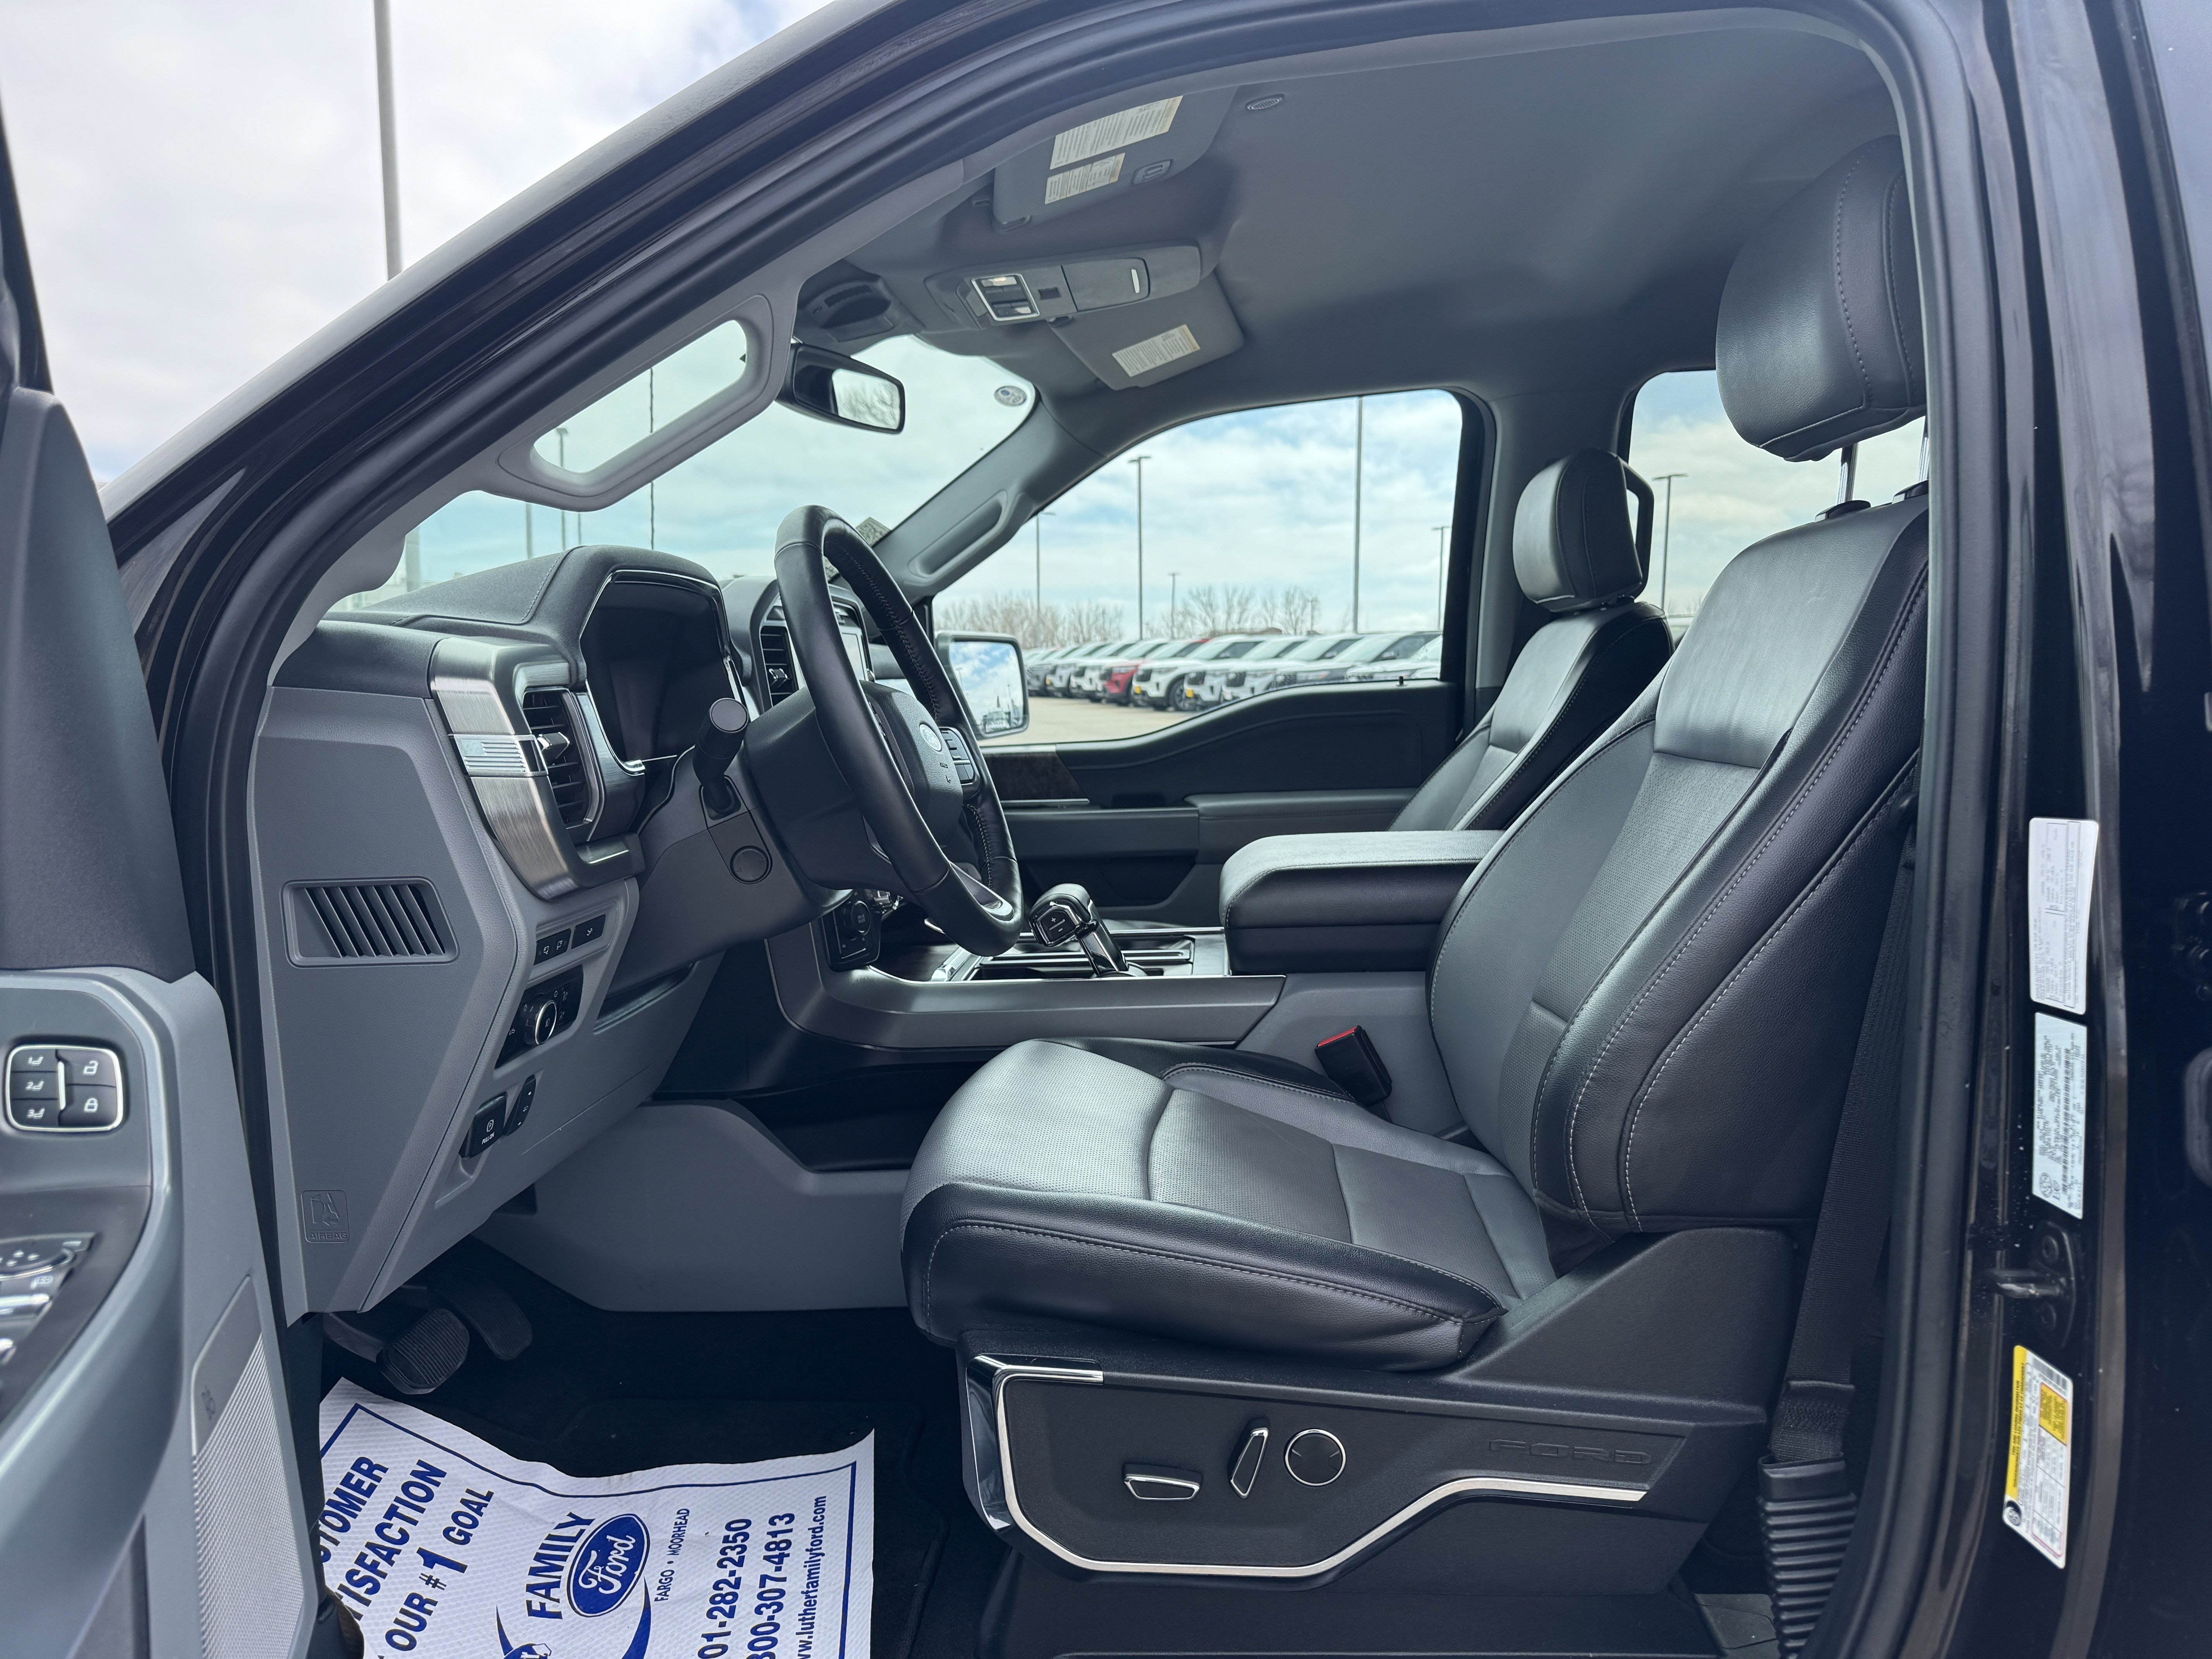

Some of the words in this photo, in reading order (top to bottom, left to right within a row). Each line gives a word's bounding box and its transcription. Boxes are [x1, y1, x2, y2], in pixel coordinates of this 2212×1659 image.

[27, 1109, 35, 1118] 3
[1489, 1439, 1651, 1465] FORD
[385, 1592, 438, 1651] OUR
[442, 1488, 495, 1546] GOAL
[526, 1511, 596, 1620] FAMILY
[578, 1535, 636, 1594] Ford
[654, 1569, 675, 1602] FARGO
[666, 1508, 690, 1556] MOORHEAD
[697, 1518, 752, 1659] 01-282-2350
